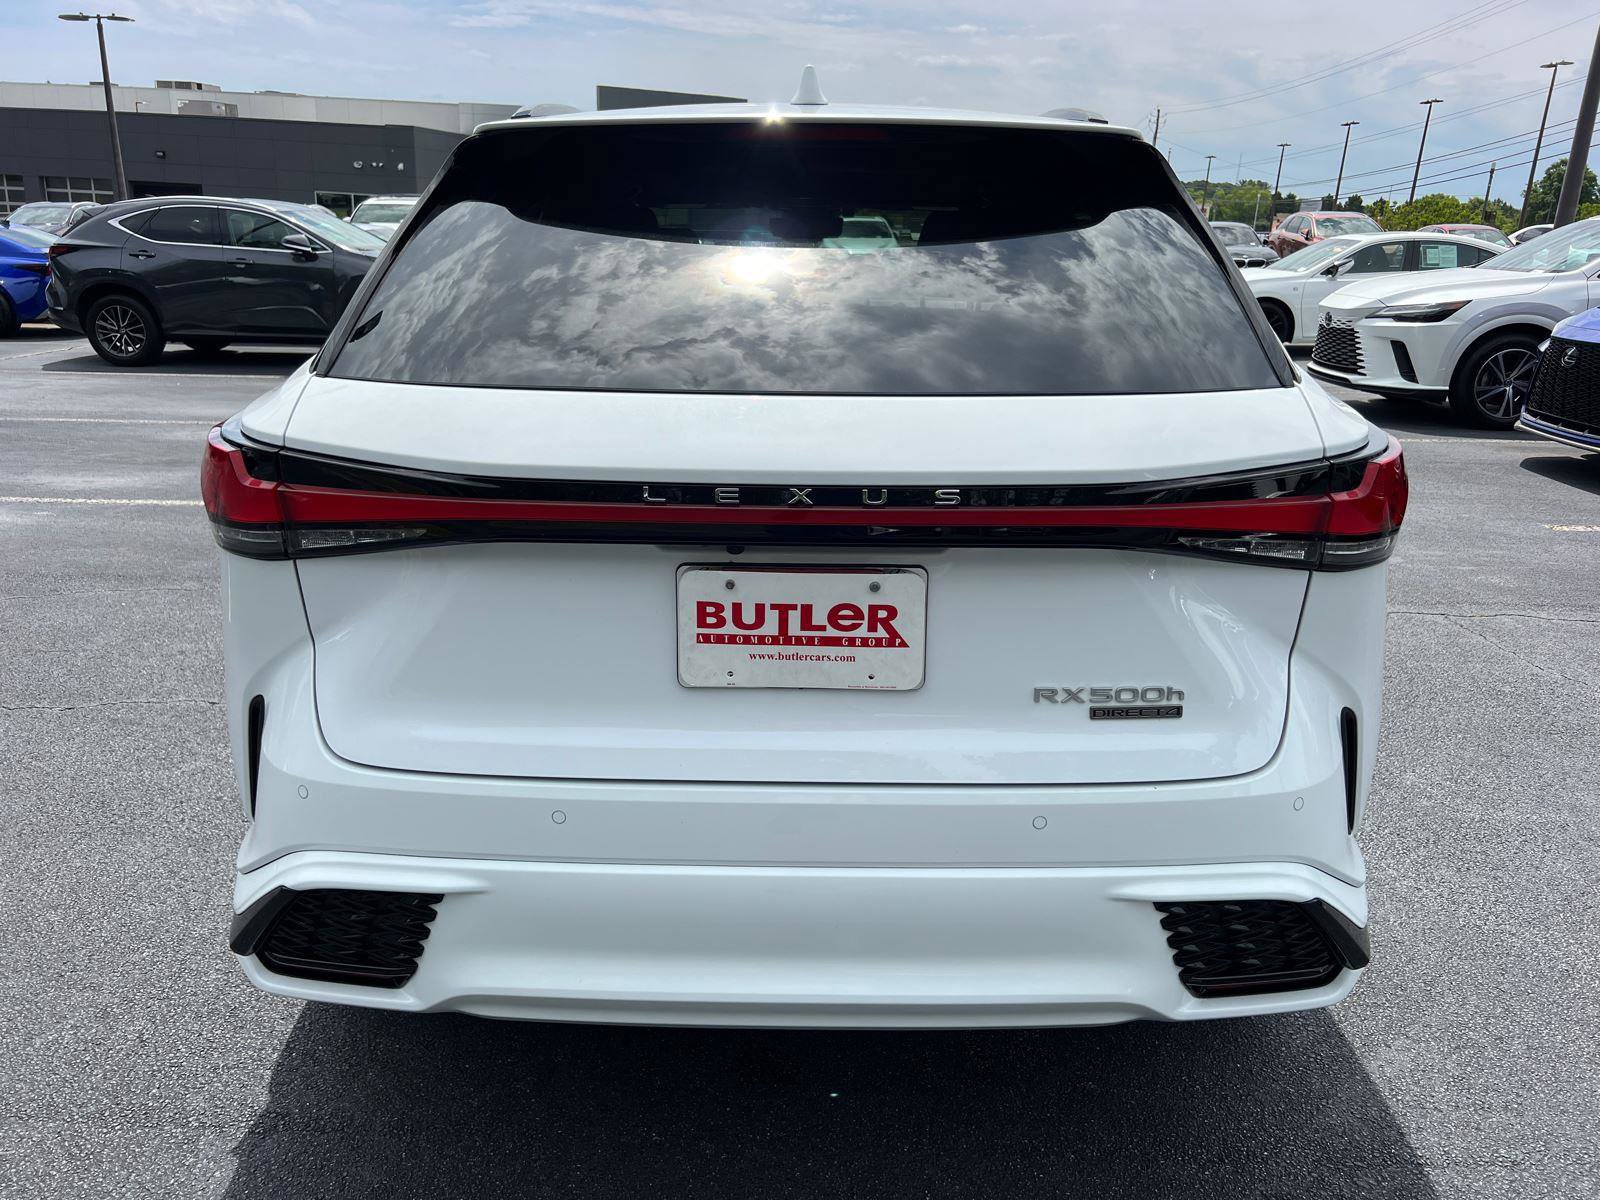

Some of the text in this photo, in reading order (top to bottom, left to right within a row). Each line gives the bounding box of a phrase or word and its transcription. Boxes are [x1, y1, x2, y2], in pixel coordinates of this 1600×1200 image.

[642, 485, 962, 506] LEXUS
[697, 634, 902, 647] AUTOMOTIVE GROUP
[749, 651, 856, 663] www.butlercars.com
[1092, 706, 1181, 719] DIRECT4
